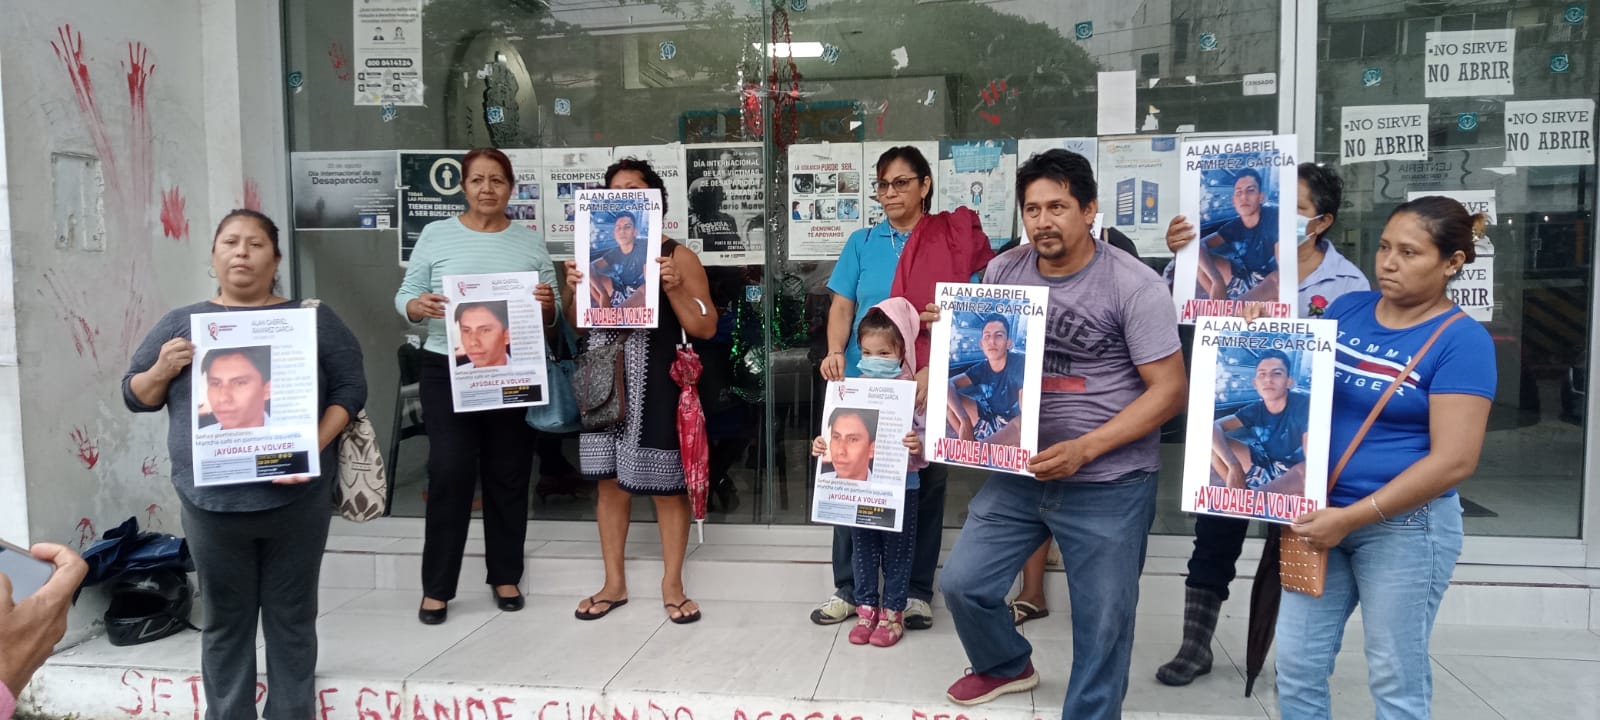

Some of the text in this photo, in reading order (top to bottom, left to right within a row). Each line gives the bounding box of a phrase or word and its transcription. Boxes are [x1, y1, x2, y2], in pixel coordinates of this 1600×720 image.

[1462, 41, 1508, 55] SIRVE
[1428, 61, 1510, 83] NO ABRIR
[1377, 116, 1422, 130] SIRVE
[1542, 111, 1589, 124] SIRVE
[1344, 134, 1425, 158] NO ABRIR
[1507, 130, 1590, 151] NO ABRIR
[1186, 140, 1280, 156] ALAN GABRIEL
[694, 158, 760, 168] DÍA INTERNACIONAL
[1246, 153, 1295, 168] GARCÍA
[551, 172, 606, 181] RECOMPENSA
[703, 169, 712, 177] DE
[728, 168, 760, 176] VÍCTIMAS
[312, 177, 379, 186] Desaparecidos
[580, 191, 649, 200] ALAN GABRIEL
[624, 201, 661, 211] GARCÍA
[1463, 202, 1489, 213] RVE
[552, 224, 557, 233] $
[1457, 269, 1487, 281] RVE
[941, 286, 1030, 300] ALAN GABRIEL
[1451, 288, 1489, 306] BRIR
[624, 308, 654, 324] VOLVER!
[995, 303, 1044, 316] GARCÍA
[1202, 320, 1315, 337] ALAN GABRIEL
[1272, 337, 1332, 352] GARCÍA
[262, 442, 294, 452] VOLVER!
[981, 442, 988, 465] A
[864, 496, 886, 505] VOLVER!
[1255, 491, 1264, 515] A
